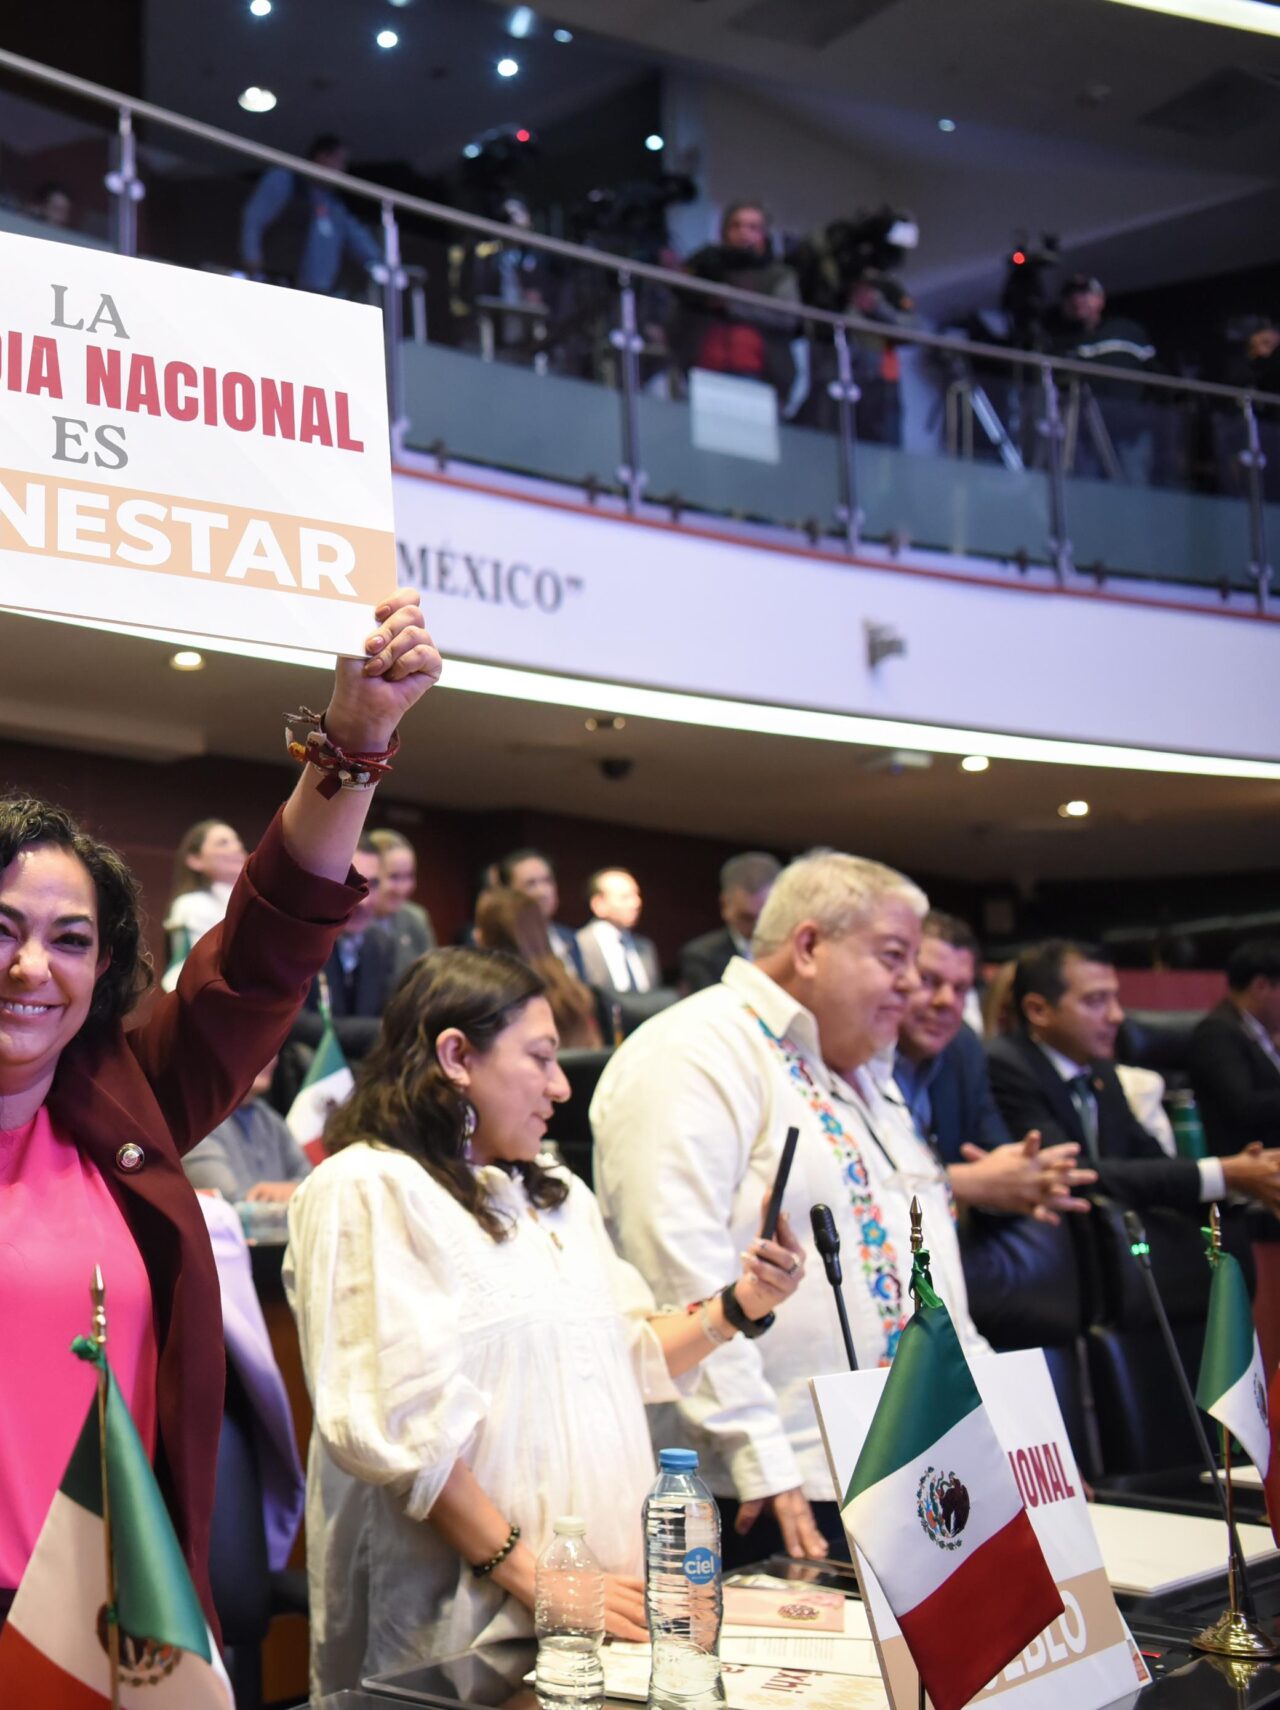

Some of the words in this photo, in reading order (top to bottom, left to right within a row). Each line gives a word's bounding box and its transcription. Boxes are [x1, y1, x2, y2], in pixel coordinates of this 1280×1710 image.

[50, 283, 131, 339] LA
[86, 344, 365, 453] NACIONAL
[51, 415, 130, 470] ES
[684, 1554, 716, 1575] ciel
